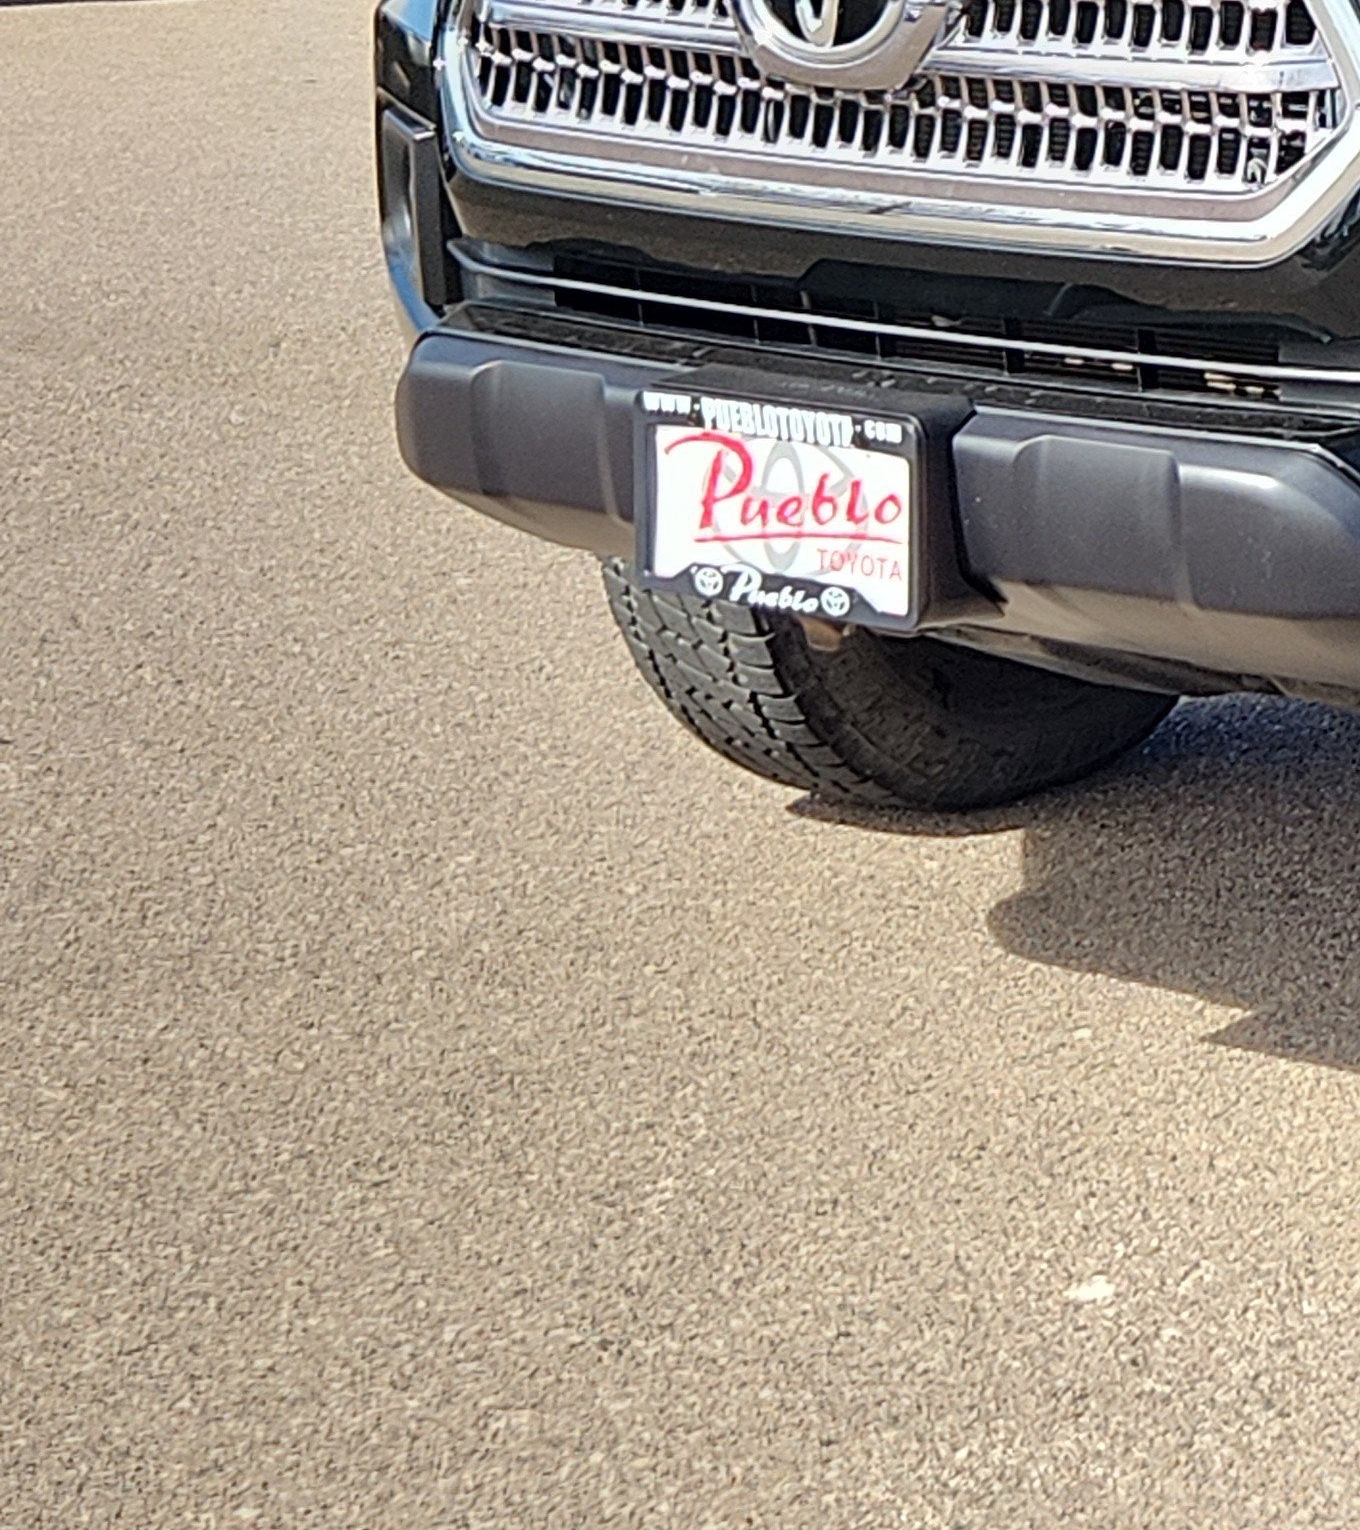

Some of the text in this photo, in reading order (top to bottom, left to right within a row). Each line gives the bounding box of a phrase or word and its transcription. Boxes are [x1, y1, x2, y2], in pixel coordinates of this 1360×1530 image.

[664, 432, 902, 530] Pueblo
[816, 548, 902, 580] TOYOTA
[721, 567, 820, 613] Pueblo
